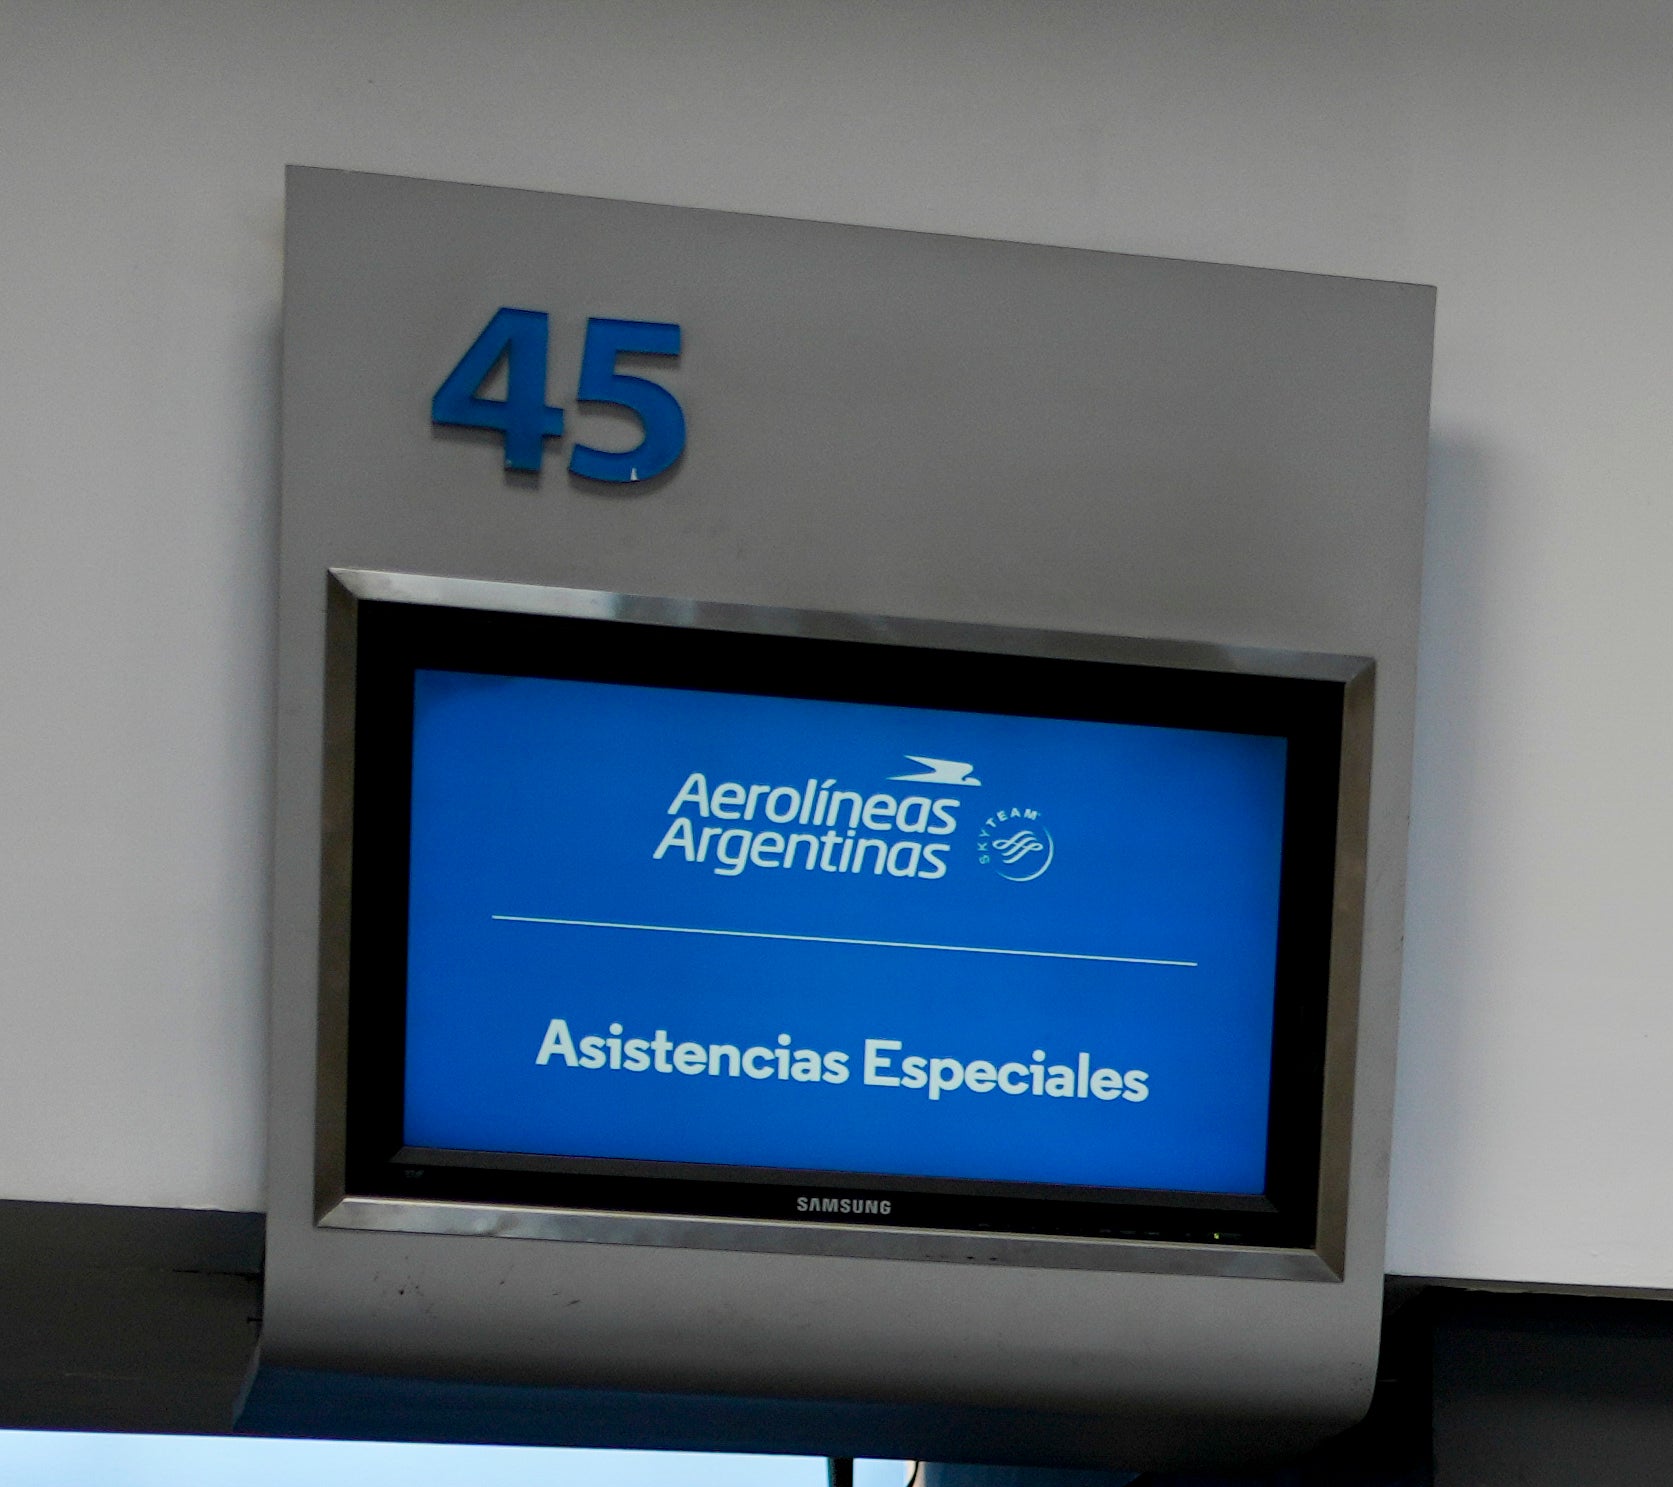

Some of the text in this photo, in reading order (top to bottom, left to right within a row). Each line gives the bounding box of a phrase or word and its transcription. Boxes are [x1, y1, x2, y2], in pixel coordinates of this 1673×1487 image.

[430, 305, 688, 483] 45
[667, 772, 961, 835] Aerolíneas
[652, 817, 951, 880] Argentinas
[977, 807, 1039, 865] SKYTEAM
[535, 1018, 1150, 1104] Asistencias Especiales
[795, 1195, 892, 1217] SAMSUNG
